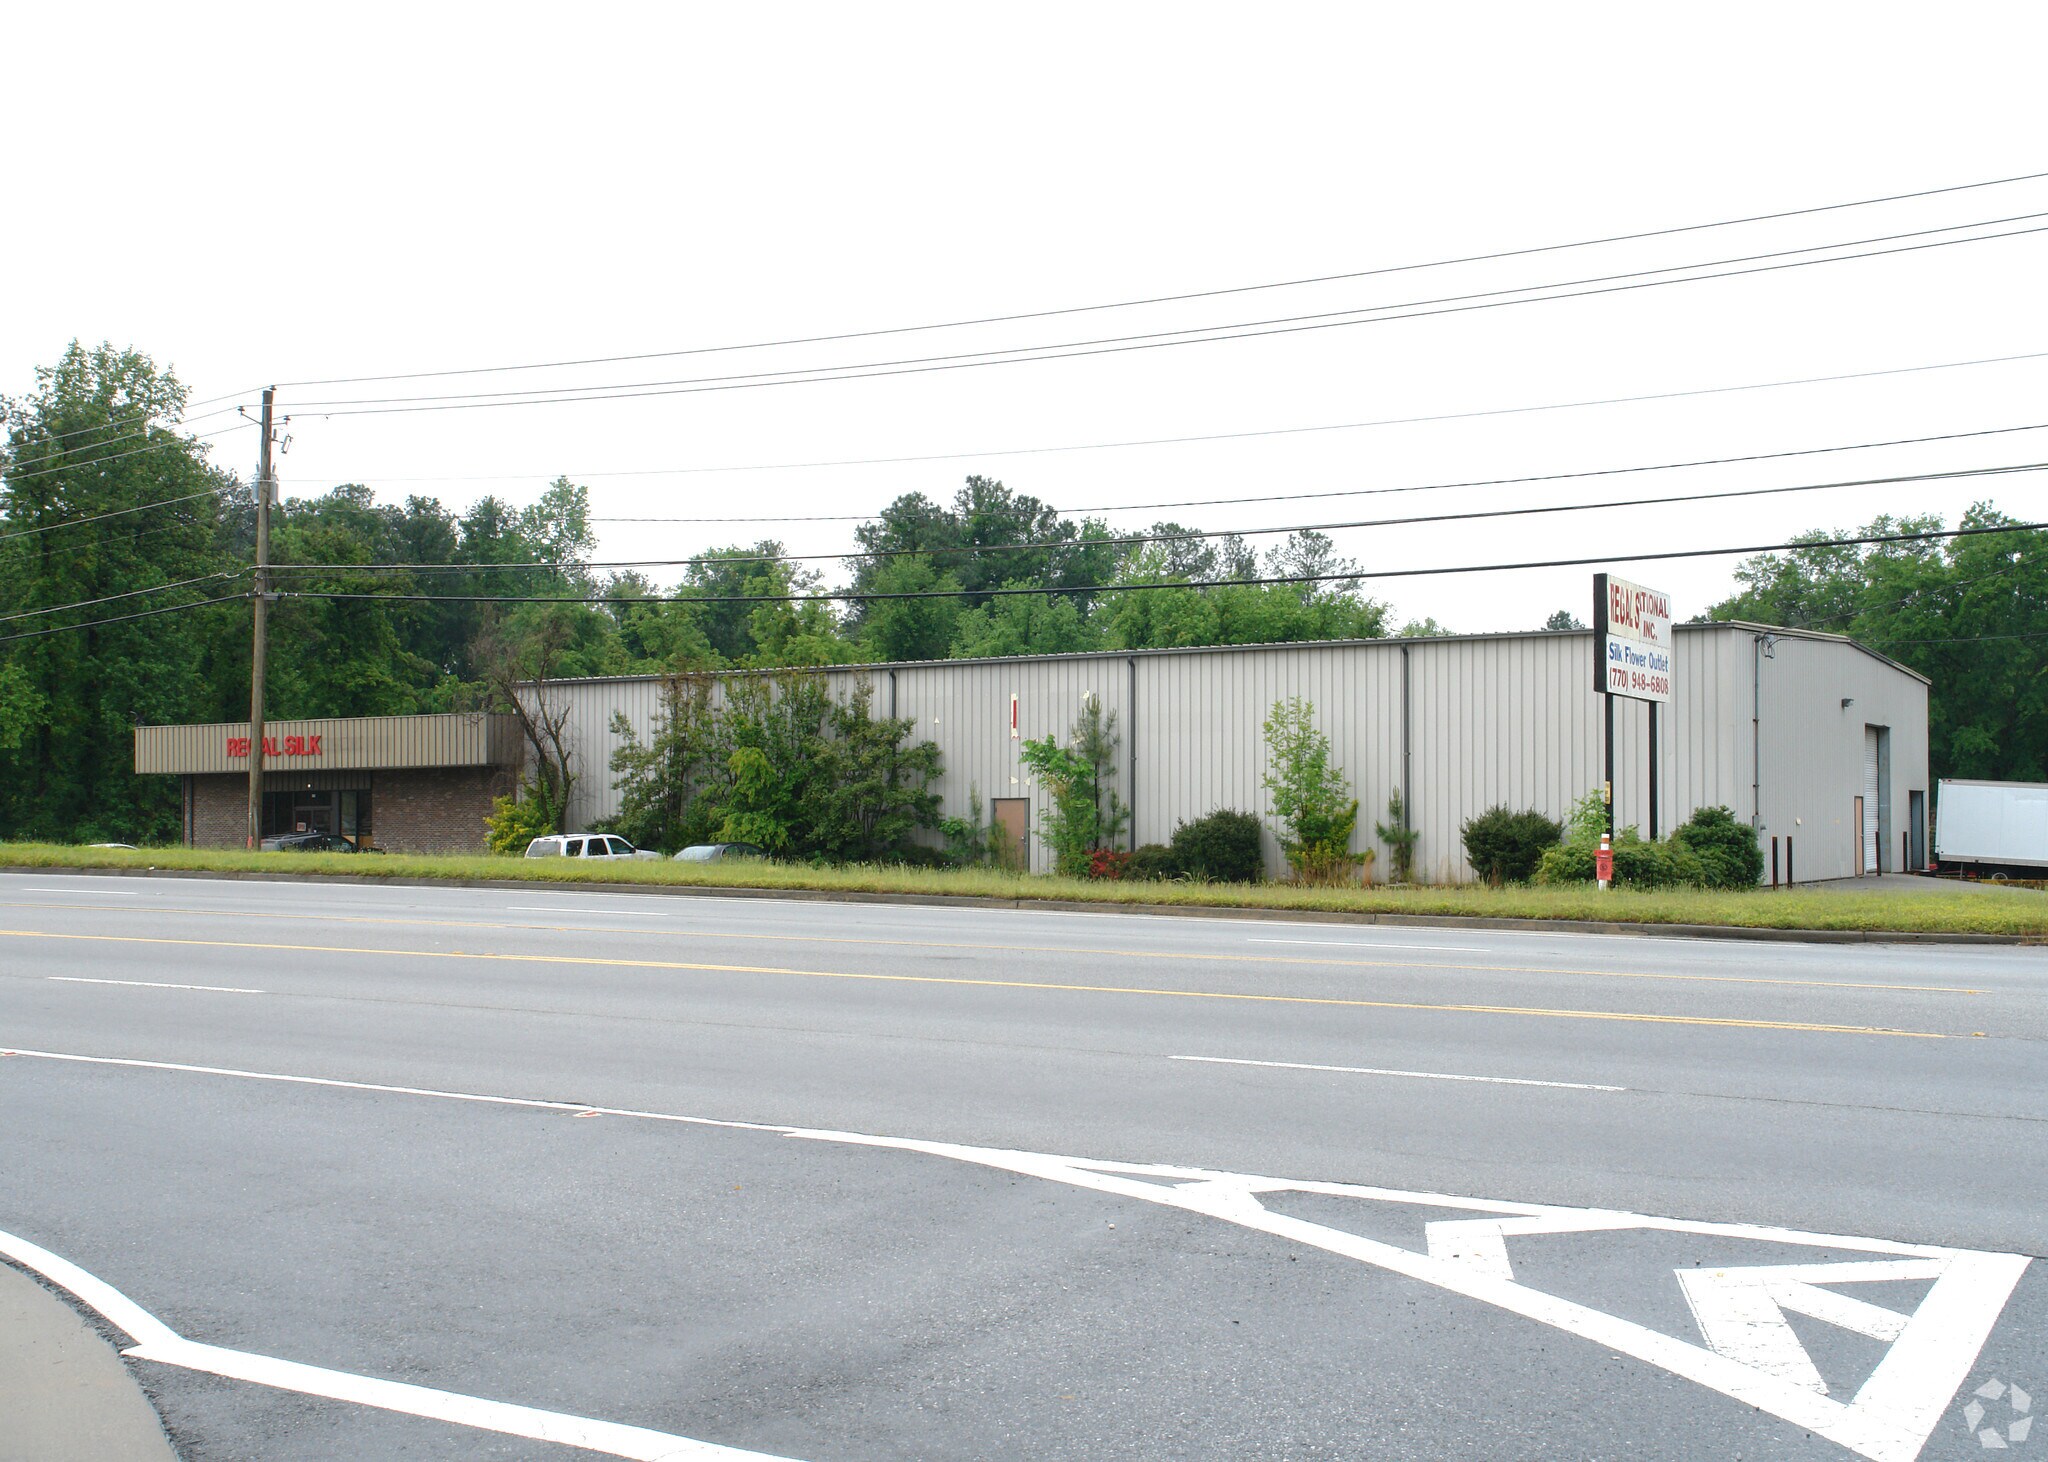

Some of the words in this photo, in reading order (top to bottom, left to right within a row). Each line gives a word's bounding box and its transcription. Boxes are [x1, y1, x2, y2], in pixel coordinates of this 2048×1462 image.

[1609, 583, 1633, 628] REGAL
[1643, 620, 1658, 640] INC.
[1609, 641, 1622, 662] Silk
[1625, 645, 1646, 668] Flower
[1649, 651, 1669, 673] Outlet
[1609, 667, 1629, 692] (770)
[1632, 671, 1669, 695] 948-6808
[284, 735, 322, 756] SILK
